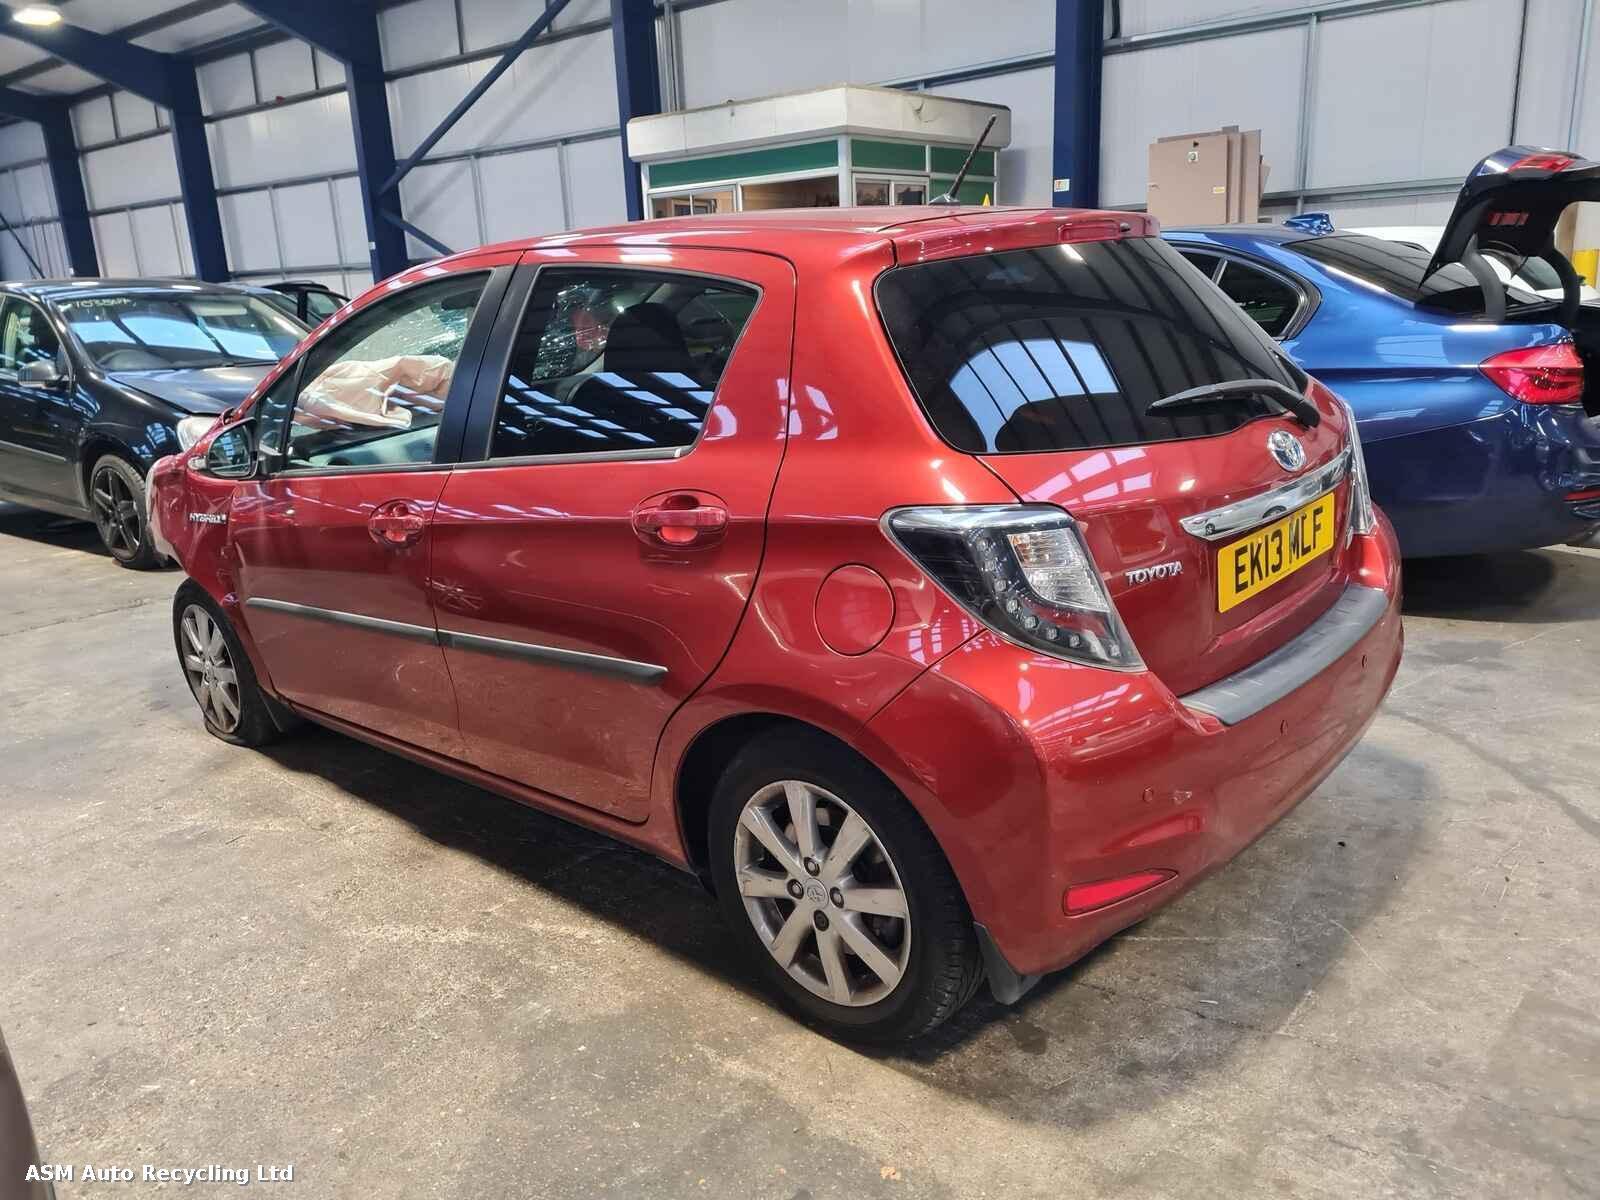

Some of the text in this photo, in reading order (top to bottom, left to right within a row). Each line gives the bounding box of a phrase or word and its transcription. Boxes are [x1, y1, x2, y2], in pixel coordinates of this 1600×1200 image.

[1125, 560, 1183, 586] TOYOTA
[1235, 505, 1323, 594] EK13 MLF
